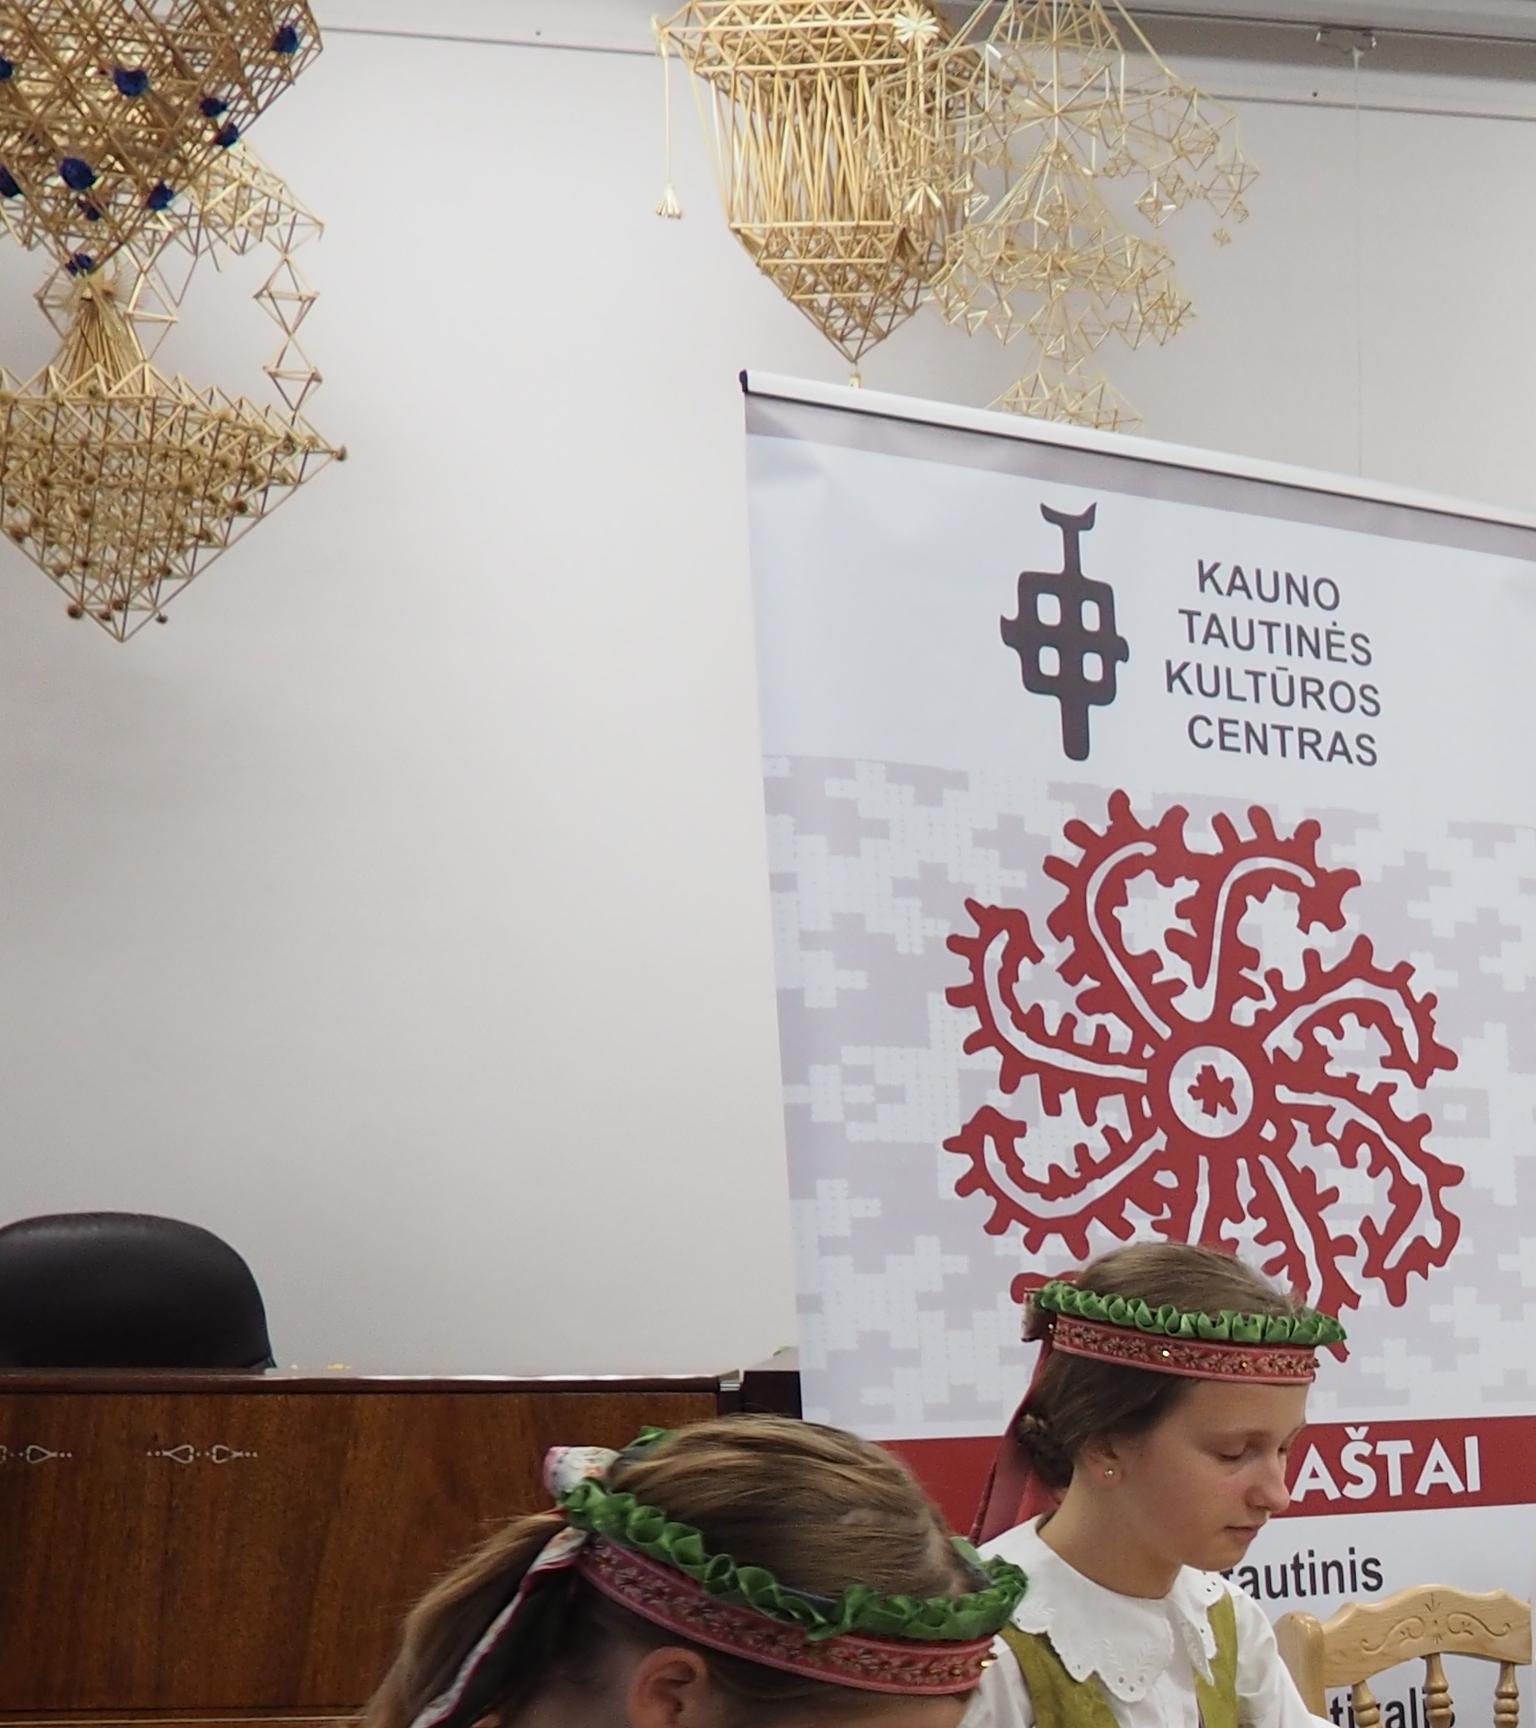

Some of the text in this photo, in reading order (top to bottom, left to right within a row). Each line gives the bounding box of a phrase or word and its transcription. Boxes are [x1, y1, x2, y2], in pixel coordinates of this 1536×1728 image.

[1197, 559, 1340, 612] KAUNO
[1177, 608, 1372, 667] TAUTINĖS
[1165, 659, 1381, 718] KULTŪROS
[1187, 714, 1378, 767] CENTRAS
[1290, 1426, 1481, 1502] AŠTAI
